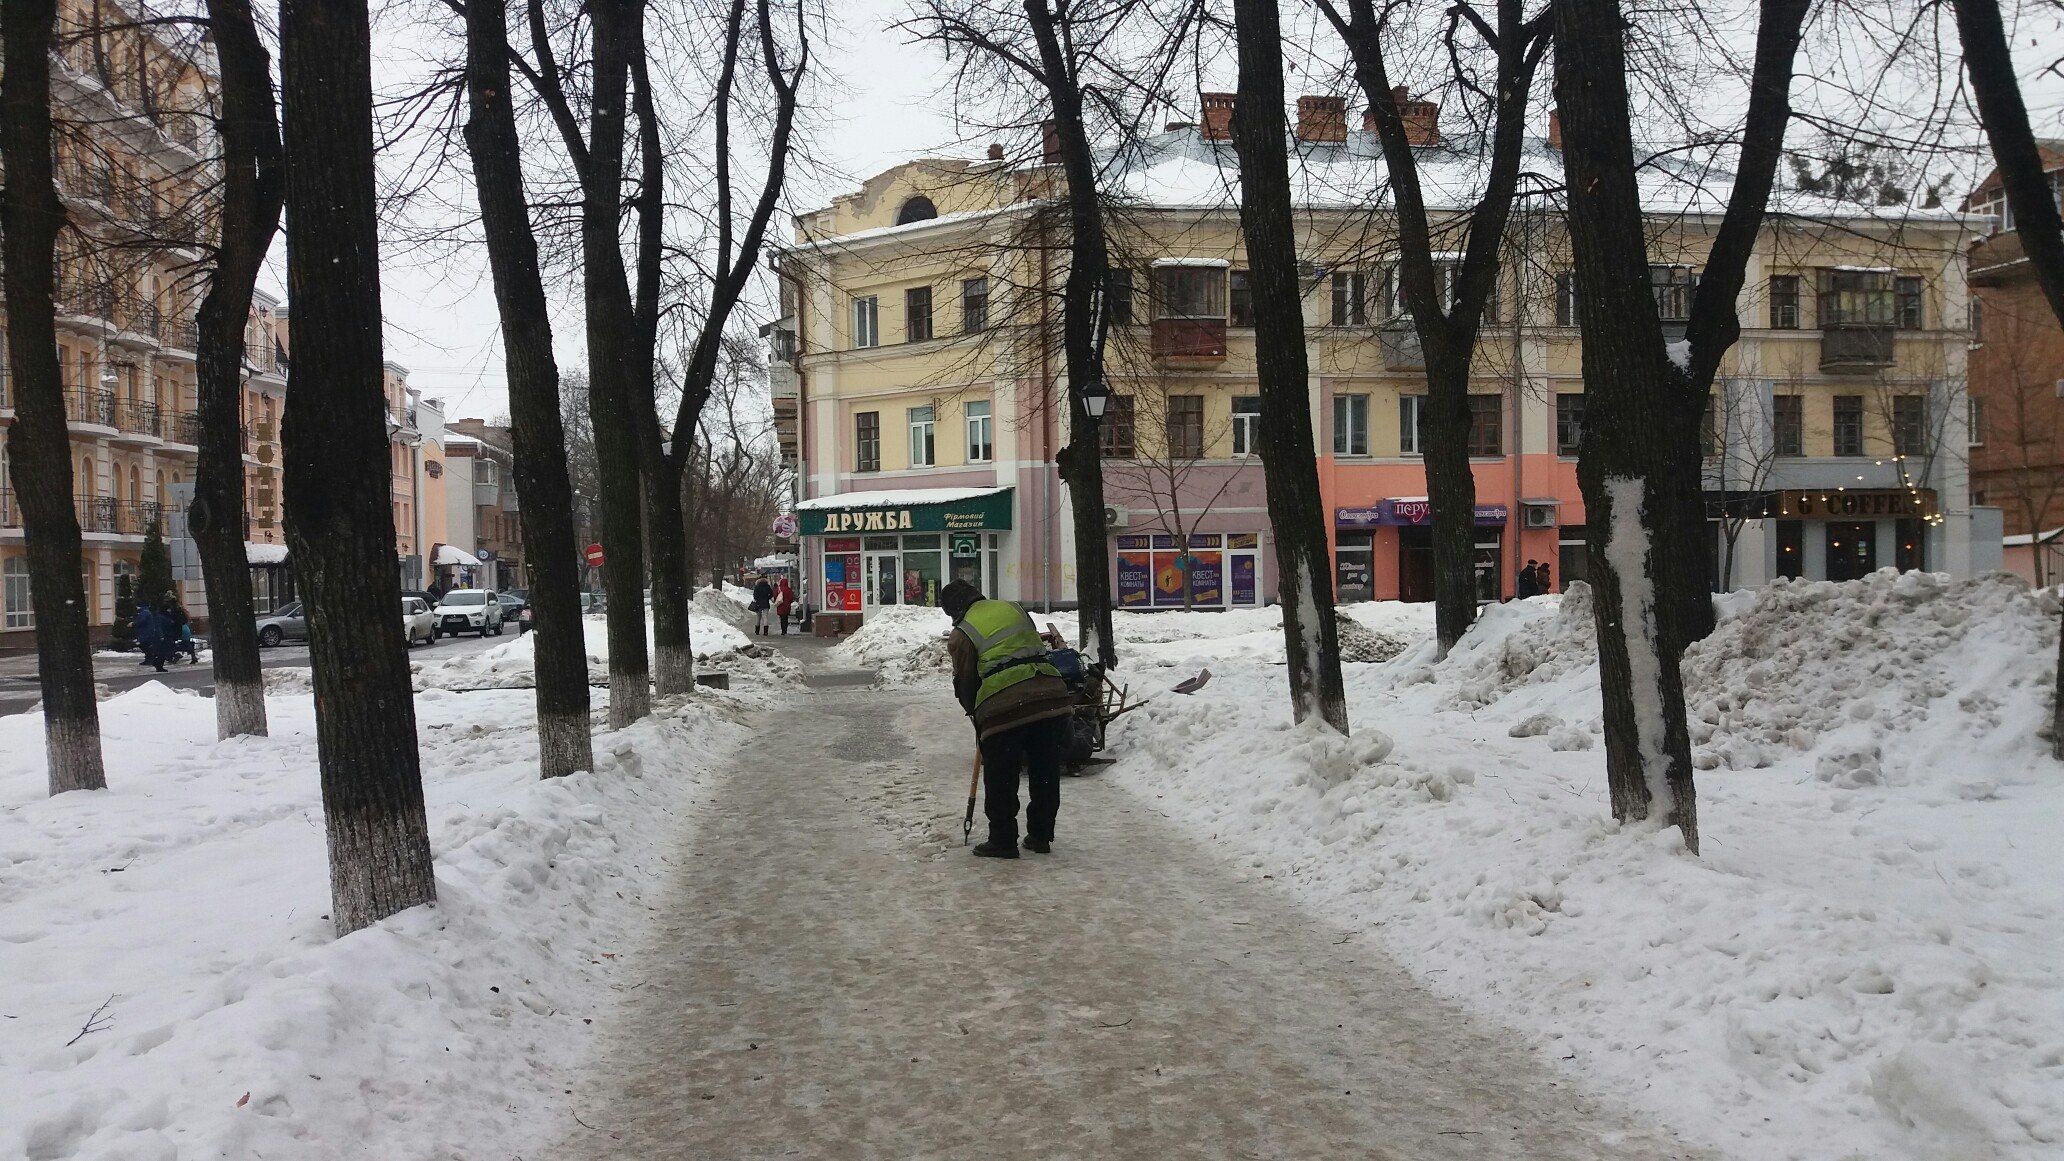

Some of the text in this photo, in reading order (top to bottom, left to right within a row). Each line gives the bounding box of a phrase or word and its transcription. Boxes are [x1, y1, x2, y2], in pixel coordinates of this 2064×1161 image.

[943, 511, 986, 521] Фірмовий
[824, 510, 913, 532] ДРУЖБА
[946, 520, 984, 529] Магазин
[1120, 571, 1142, 580] КВЕСТ
[1192, 570, 1214, 580] КВЕСТ
[1120, 580, 1145, 588] КОМНАТЫ
[1192, 579, 1217, 587] КОМНАТЫ
